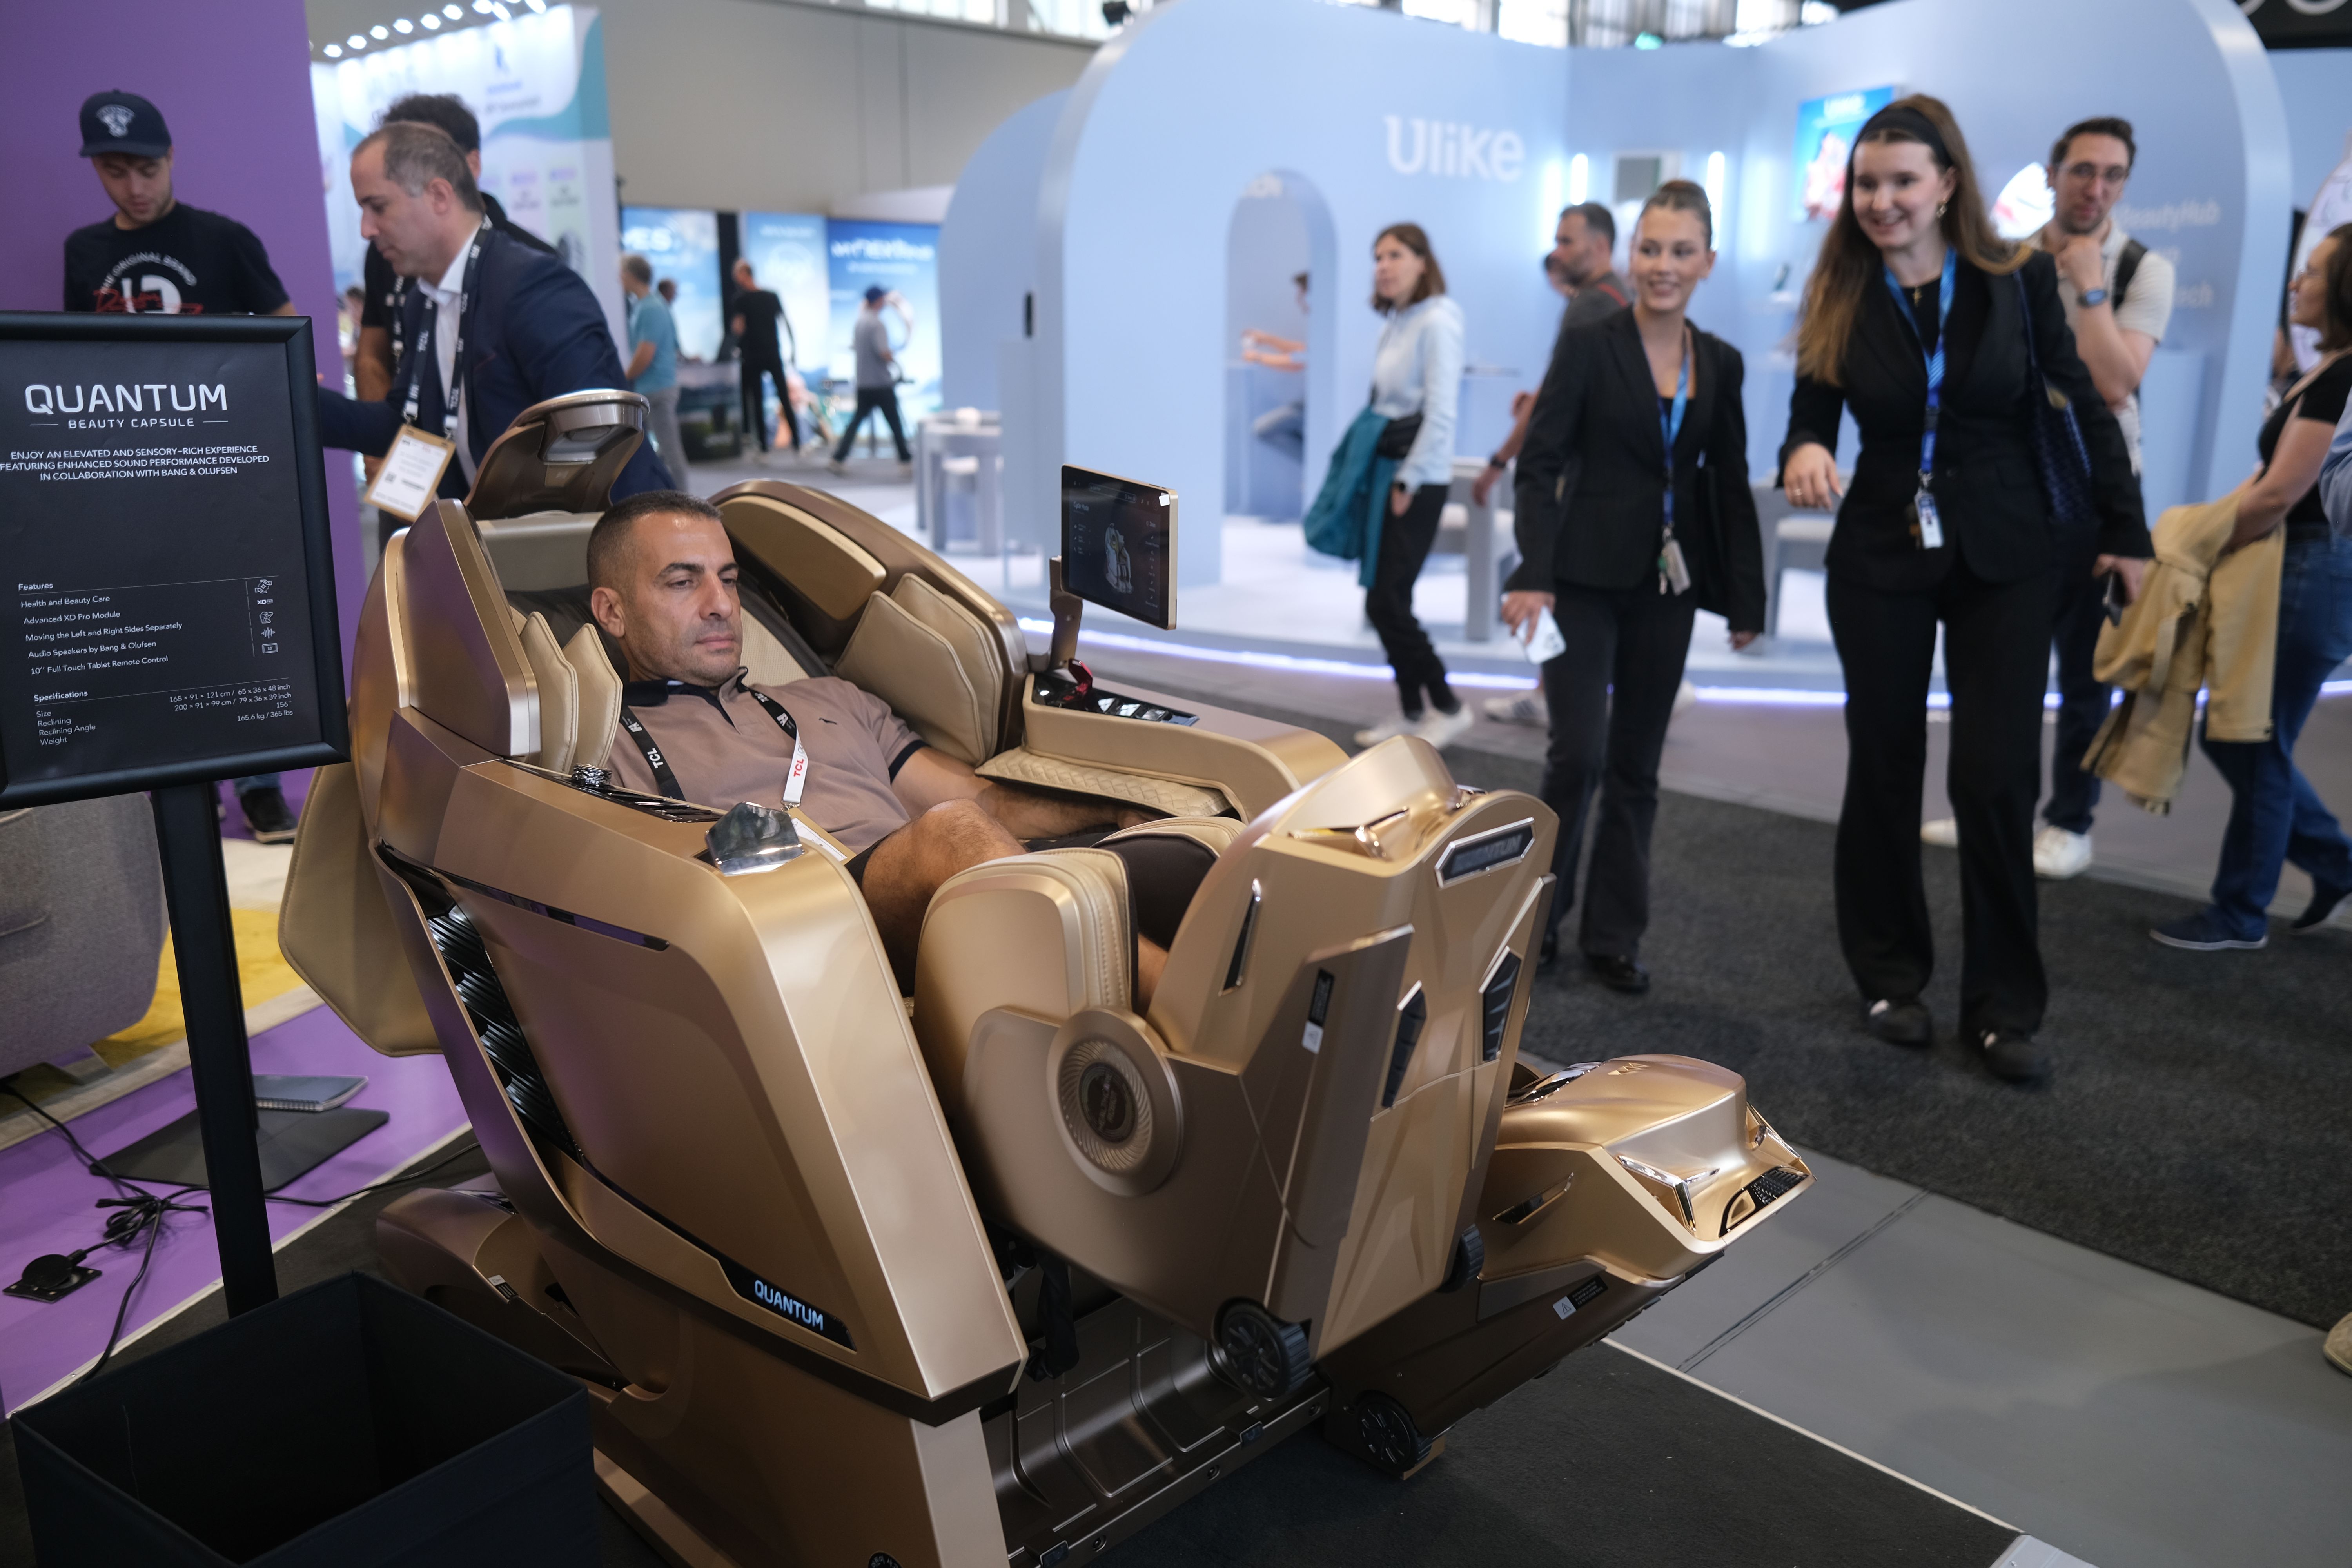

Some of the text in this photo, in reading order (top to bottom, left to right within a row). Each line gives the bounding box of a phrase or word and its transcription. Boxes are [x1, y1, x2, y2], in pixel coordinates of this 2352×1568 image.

[1383, 115, 1525, 183] Ulike
[25, 384, 227, 415] QUANTUM
[68, 418, 194, 429] BEAUTY CAPSULE
[47, 450, 61, 459] AN
[205, 446, 258, 454] EXPERIENCE
[0, 462, 55, 471] FEATURING
[57, 461, 112, 469] ENHANCED
[150, 457, 217, 466] PERFORMANCE
[219, 456, 269, 464] DEVELOPED
[40, 473, 51, 481] IN
[53, 470, 134, 480] COLLABORATION
[21, 599, 46, 608] Health
[24, 615, 62, 624] Advanced
[92, 611, 120, 619] Module
[103, 627, 123, 635] Right
[145, 622, 182, 632] Separately
[28, 650, 51, 658] Audio
[53, 648, 87, 657] Speakers
[89, 646, 98, 654] by
[62, 663, 85, 671] Touch
[142, 655, 168, 664] Control
[34, 691, 88, 703] Specifications
[38, 718, 71, 726] Reclining
[39, 724, 96, 736] Reclining Angle
[40, 736, 67, 745] Weight
[647, 748, 664, 769] TCL
[793, 759, 804, 778] TCL
[755, 1280, 823, 1331] QUANTUM
